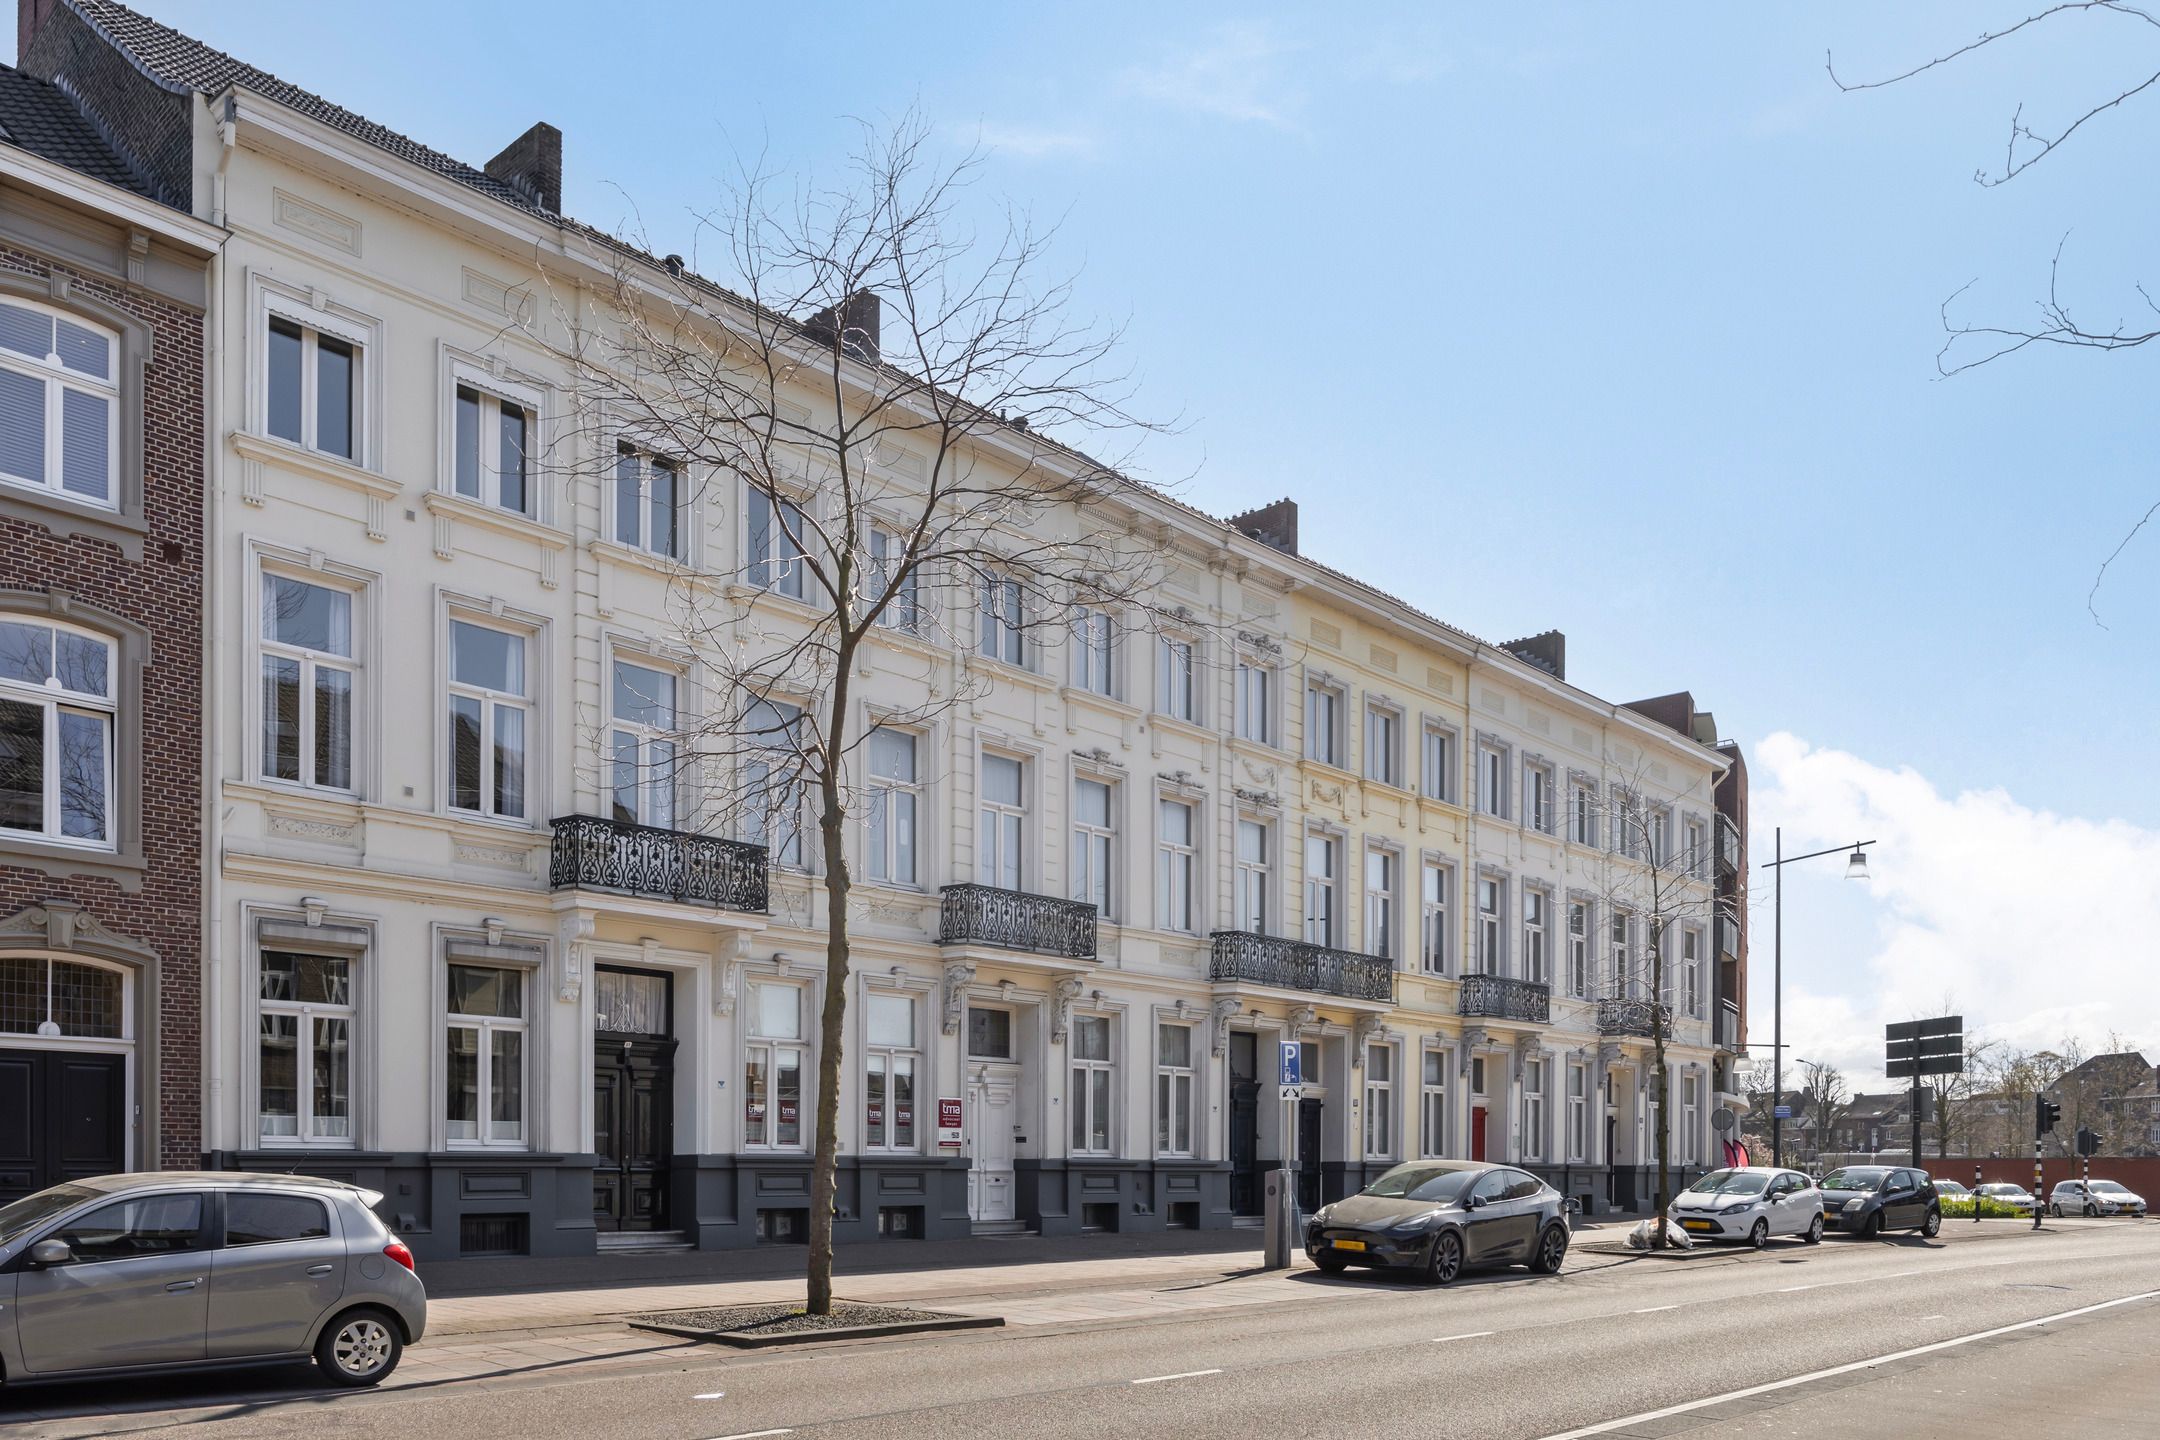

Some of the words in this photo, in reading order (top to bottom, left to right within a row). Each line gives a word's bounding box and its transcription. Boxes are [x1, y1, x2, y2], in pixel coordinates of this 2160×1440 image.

[1285, 1045, 1296, 1066] P
[782, 1106, 796, 1115] tma
[943, 1102, 960, 1114] tma
